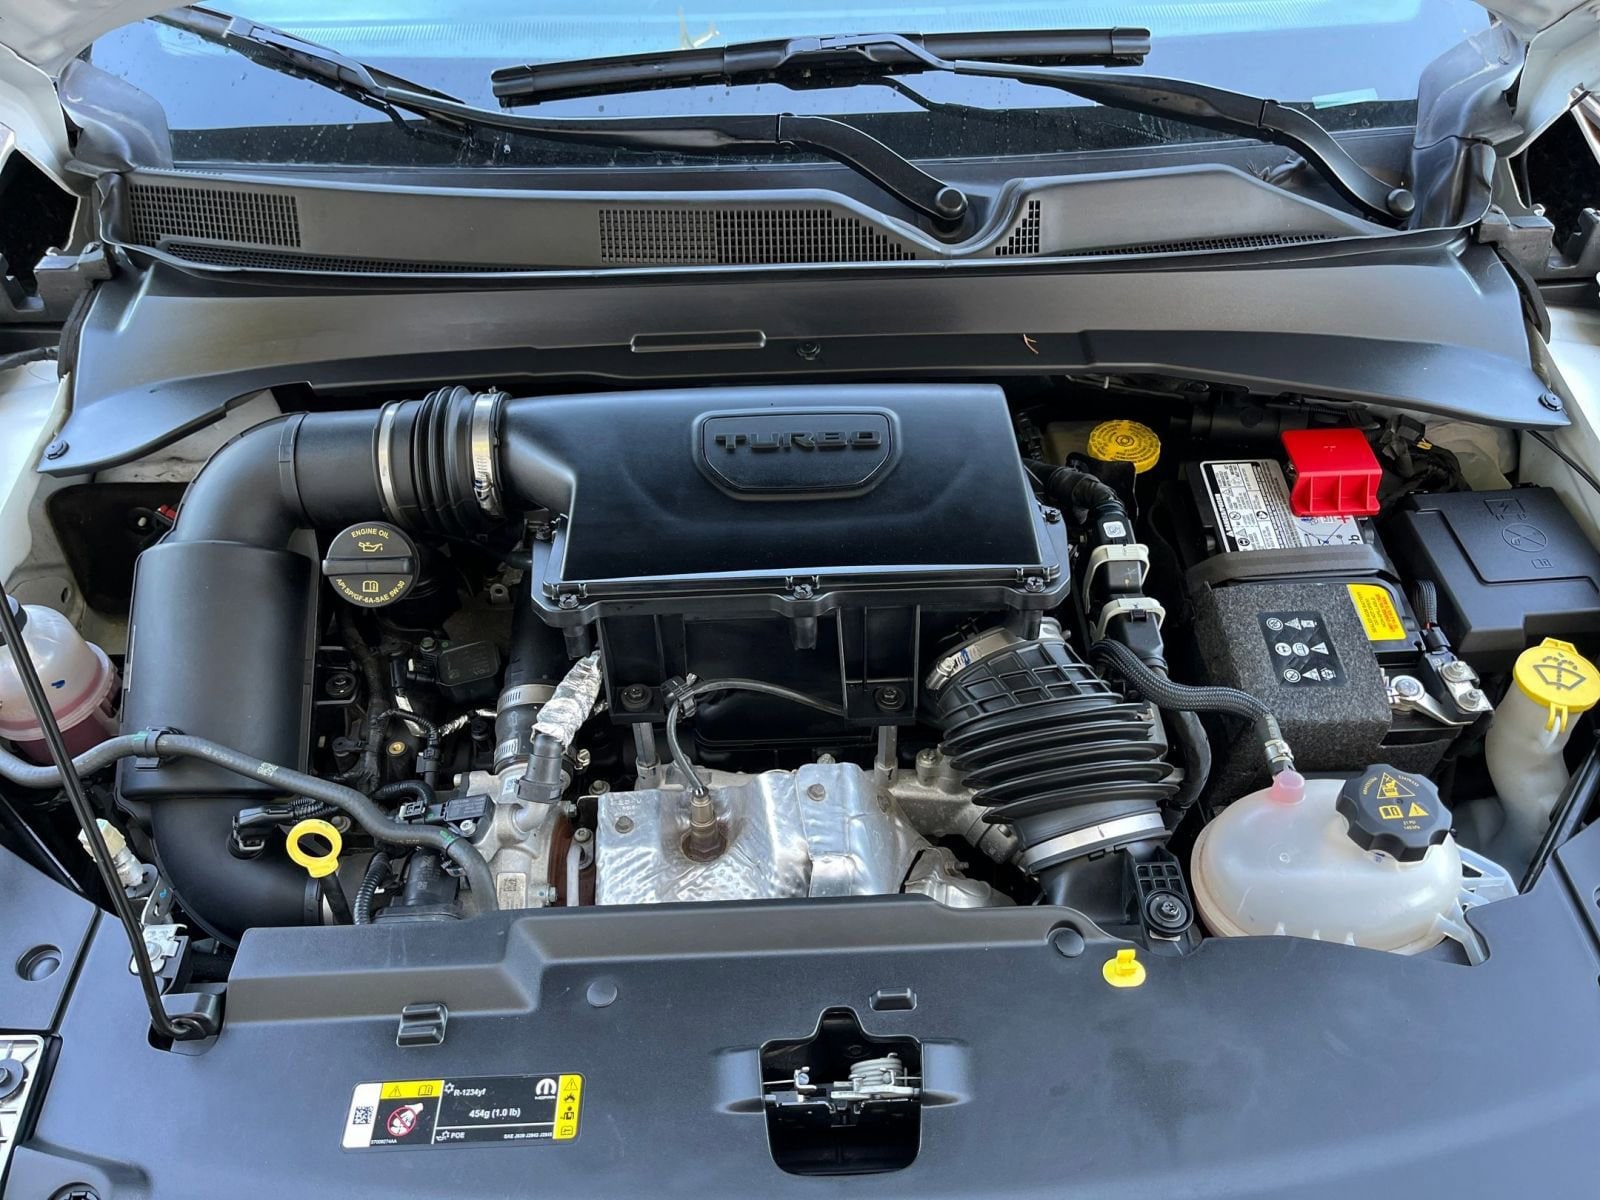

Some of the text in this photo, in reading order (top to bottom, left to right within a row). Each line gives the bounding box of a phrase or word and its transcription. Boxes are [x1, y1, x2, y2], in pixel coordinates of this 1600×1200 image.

[714, 431, 882, 449] TURBO
[351, 528, 390, 539] ENGINE OIL
[336, 578, 346, 590] API
[388, 580, 405, 597] 5W-30
[453, 1087, 487, 1097] R-1234yf
[469, 1107, 521, 1119] 454g (1.0 lb)
[450, 1131, 465, 1139] POE
